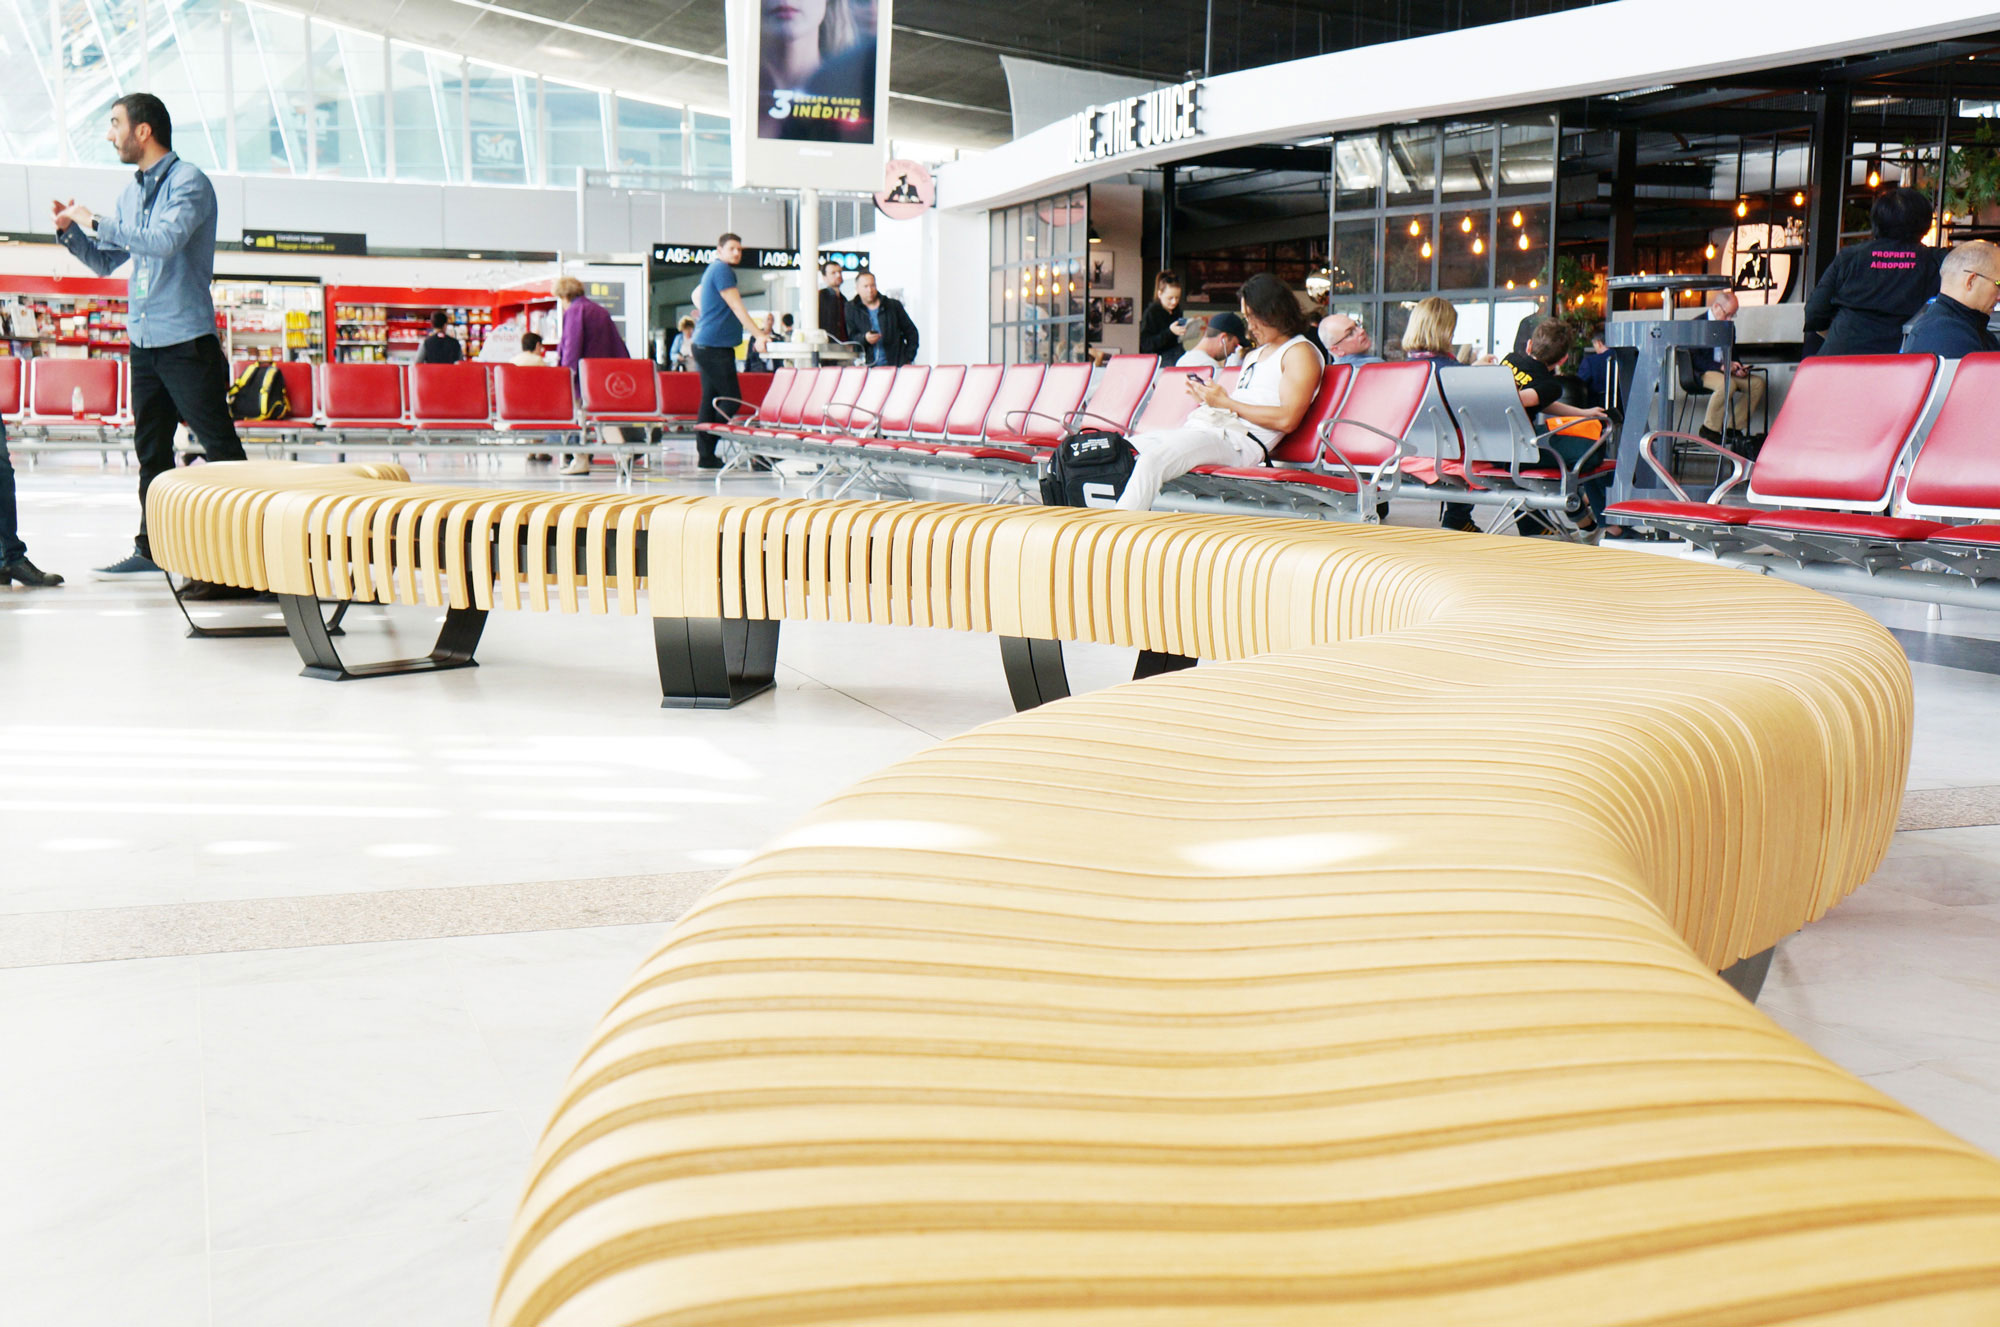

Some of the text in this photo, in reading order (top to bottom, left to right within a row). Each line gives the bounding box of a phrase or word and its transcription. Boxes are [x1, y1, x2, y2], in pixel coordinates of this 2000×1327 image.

[768, 89, 793, 119] 3
[830, 97, 861, 106] GAMES
[793, 102, 860, 120] INÉDITS
[1067, 104, 1096, 163] JOE
[1104, 96, 1138, 156] THE
[1138, 80, 1197, 148] JUICE
[665, 247, 690, 264] A05
[763, 251, 789, 267] A09
